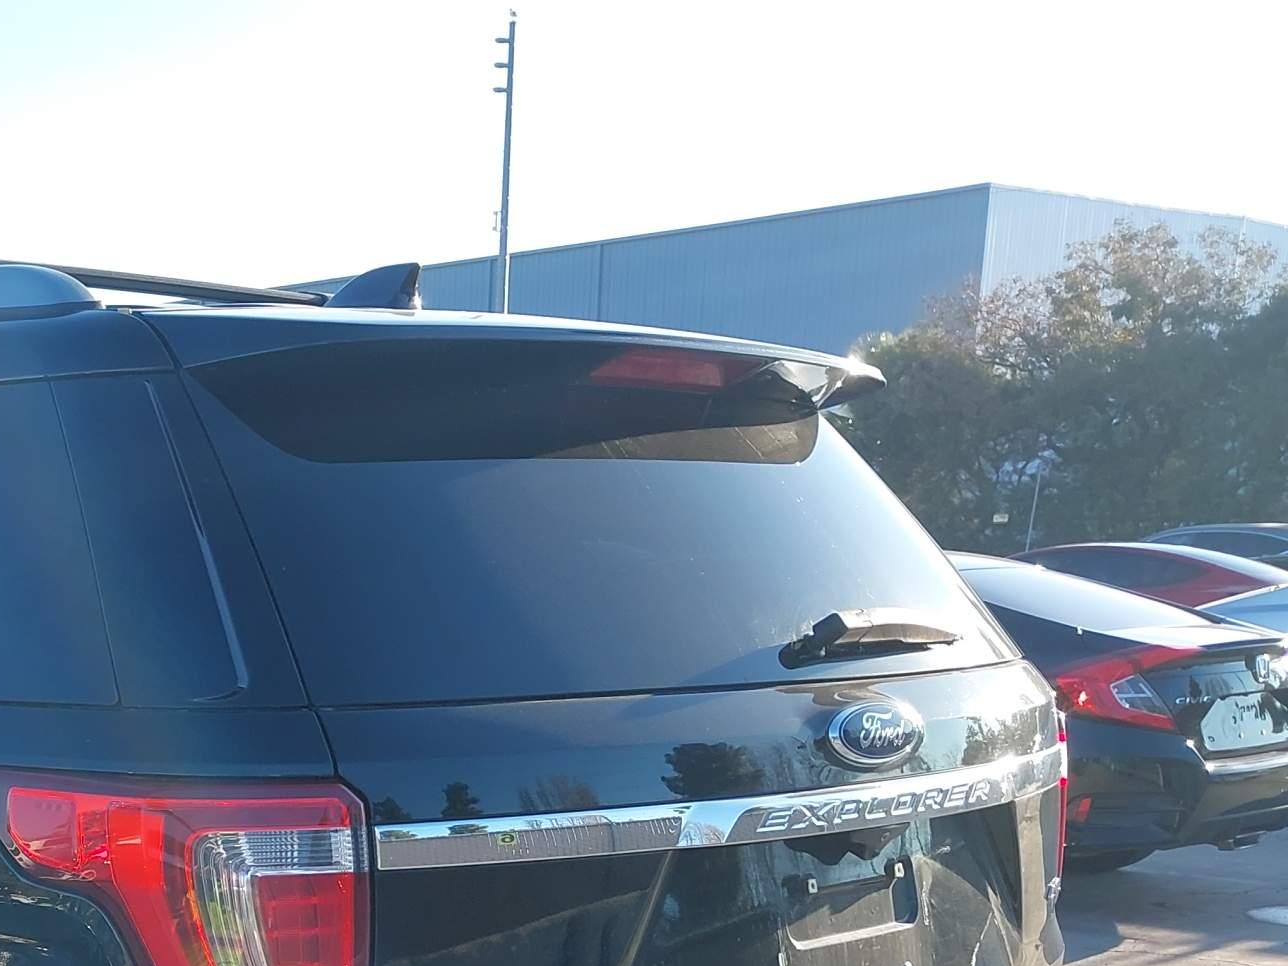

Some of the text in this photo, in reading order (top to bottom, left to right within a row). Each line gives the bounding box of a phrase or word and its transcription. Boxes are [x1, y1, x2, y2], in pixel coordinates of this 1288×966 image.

[1175, 695, 1212, 704] CIVIC
[860, 711, 907, 748] Ford
[755, 778, 993, 833] EXPLORER
